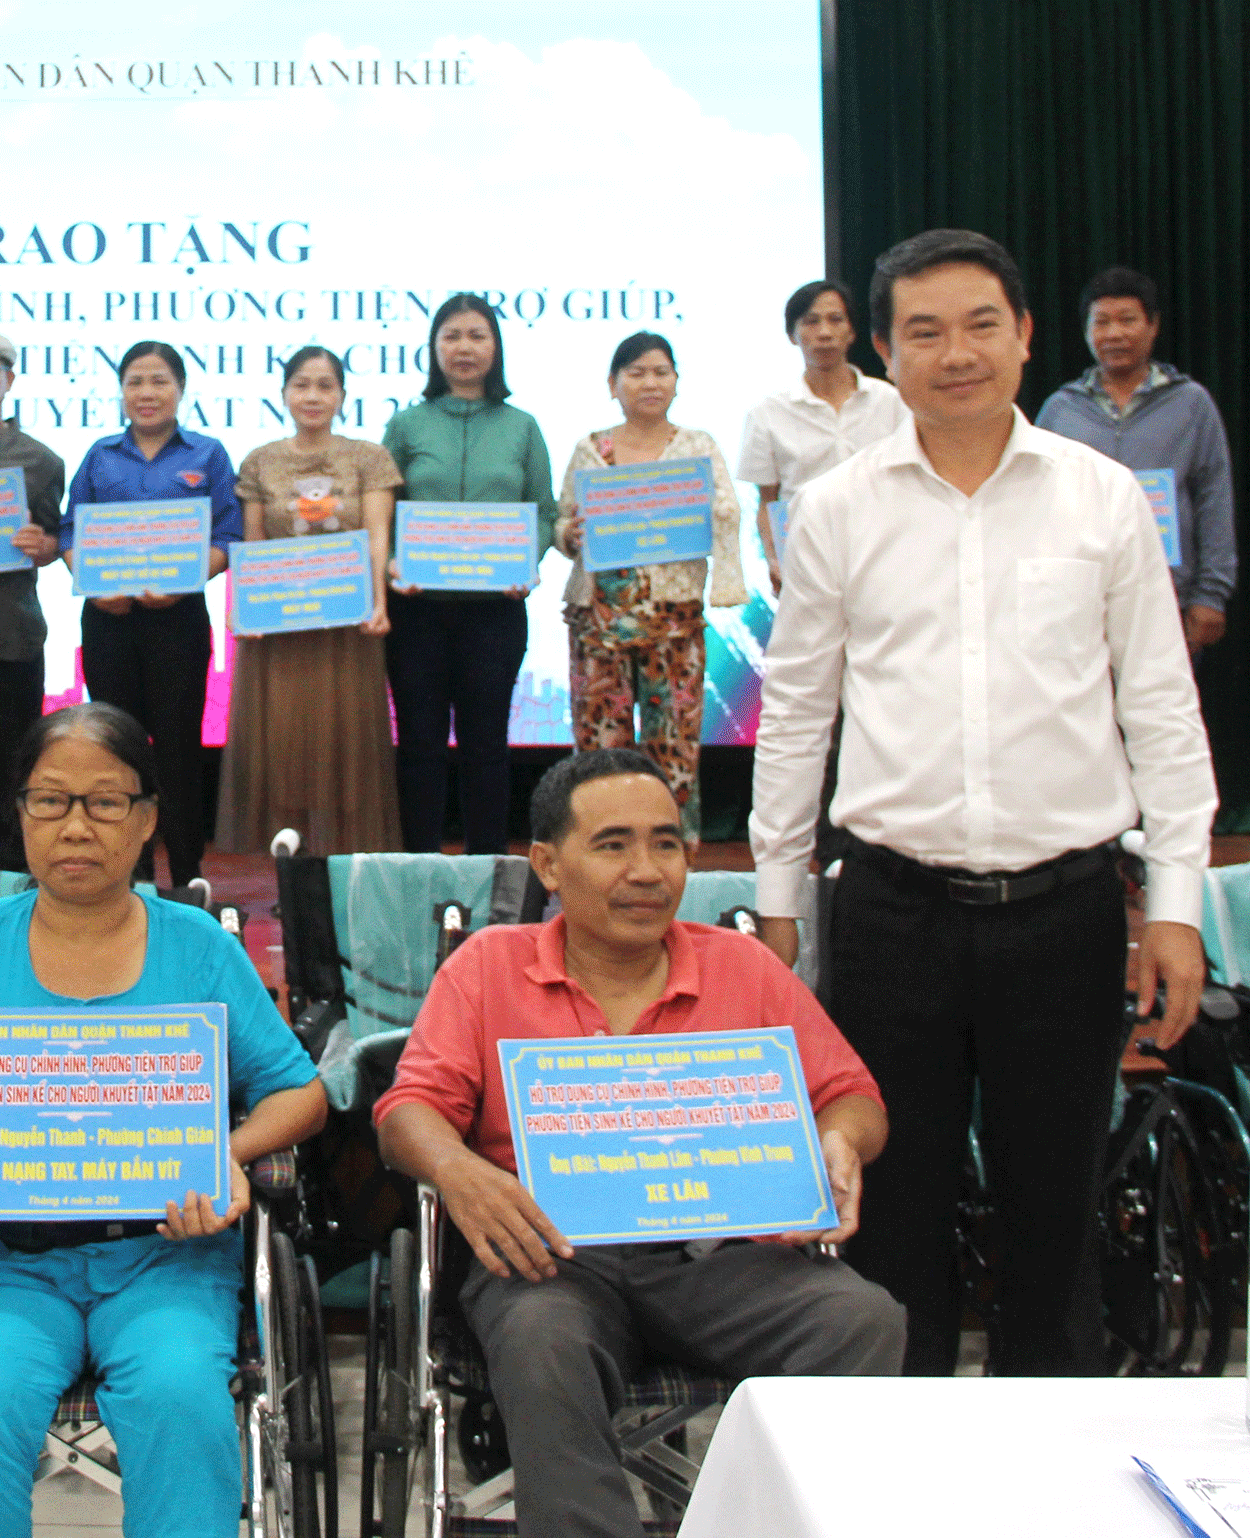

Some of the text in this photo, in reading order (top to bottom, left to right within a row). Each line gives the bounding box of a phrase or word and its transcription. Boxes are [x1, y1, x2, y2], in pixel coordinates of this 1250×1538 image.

[37, 53, 115, 90] DÂN
[126, 60, 237, 95] QUẬN
[247, 59, 383, 87] THANH
[390, 50, 475, 86] KHÊ
[124, 214, 314, 276] TẶNG
[104, 285, 306, 322] PHƯƠNG
[320, 284, 434, 330] TIỆN
[562, 279, 682, 326] GIÚP,
[13, 339, 121, 384] TIỆN
[11, 1024, 48, 1039] NHÂN
[51, 1024, 78, 1038] DÂN
[81, 1024, 117, 1040] QUẬN
[120, 1025, 162, 1038] THANH
[165, 1022, 190, 1037] KHÊ
[14, 1055, 28, 1079] CỤ
[30, 1049, 61, 1076] CHỈNH
[62, 1051, 89, 1078] HÌNH,
[91, 1053, 132, 1076] PHƯƠNG
[134, 1050, 156, 1079] TIỆN
[158, 1052, 178, 1079] TRỢ
[179, 1049, 203, 1074] GIÚP
[537, 1045, 764, 1070] ỦY BAN NHÂN DÂN QUẬN THANH KHÊ
[6, 1084, 30, 1106] SINH
[32, 1079, 48, 1106] KẾ
[48, 1084, 68, 1106] CHO
[69, 1079, 100, 1105] NGƯỜI
[102, 1078, 139, 1106] KHUYẾT
[141, 1080, 159, 1109] TẬT
[161, 1079, 185, 1105] NĂM
[187, 1082, 211, 1104] 2024
[529, 1079, 544, 1105] HỖ
[545, 1083, 567, 1108] TRỢ
[566, 1083, 595, 1108] DỤNG
[595, 1083, 611, 1107] CỤ
[611, 1077, 643, 1102] CHỈNH
[672, 1076, 714, 1099] PHƯƠNG
[713, 1073, 738, 1100] TIỆN
[736, 1073, 758, 1098] TRỢ
[758, 1069, 783, 1094] GIÚP
[526, 1100, 798, 1137] PHƯƠNG TIỆN SINH KẾ CHO NGƯỜI KHUYẾT TẬT NĂM 2024
[0, 1125, 46, 1148] Nguyễn
[49, 1127, 86, 1146] Thanh
[97, 1126, 144, 1147] Phường
[147, 1126, 183, 1145] Chính
[186, 1126, 214, 1145] Gián
[2, 1161, 46, 1185] NẠNG
[82, 1158, 117, 1180] MÁY
[157, 1157, 181, 1180] VÍT
[550, 1152, 571, 1175] Ông
[597, 1150, 637, 1174] Nguyễn
[699, 1148, 740, 1167] Phường
[29, 1195, 119, 1207] Tháng 2024
[645, 1179, 709, 1203] XE LĂN
[637, 1213, 728, 1228] Tháng 2024
